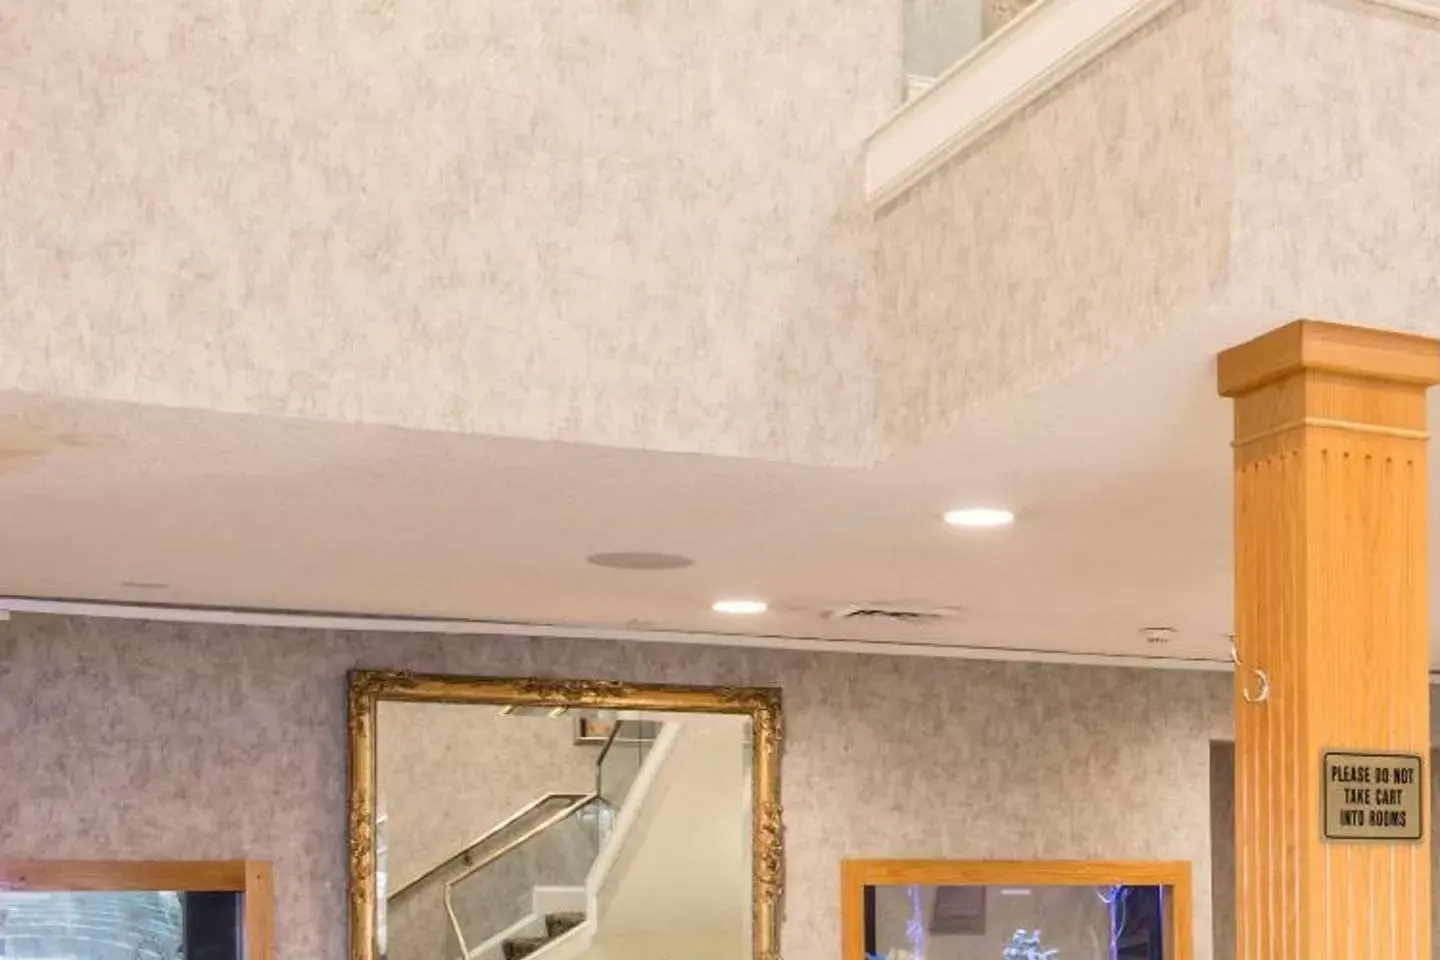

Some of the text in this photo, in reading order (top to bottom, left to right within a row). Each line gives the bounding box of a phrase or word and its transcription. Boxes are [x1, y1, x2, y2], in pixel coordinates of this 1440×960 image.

[1332, 766, 1414, 784] PLEASE DO NOT
[1344, 788, 1402, 805] TAKE CART
[1340, 810, 1406, 827] INTO ROOMS
